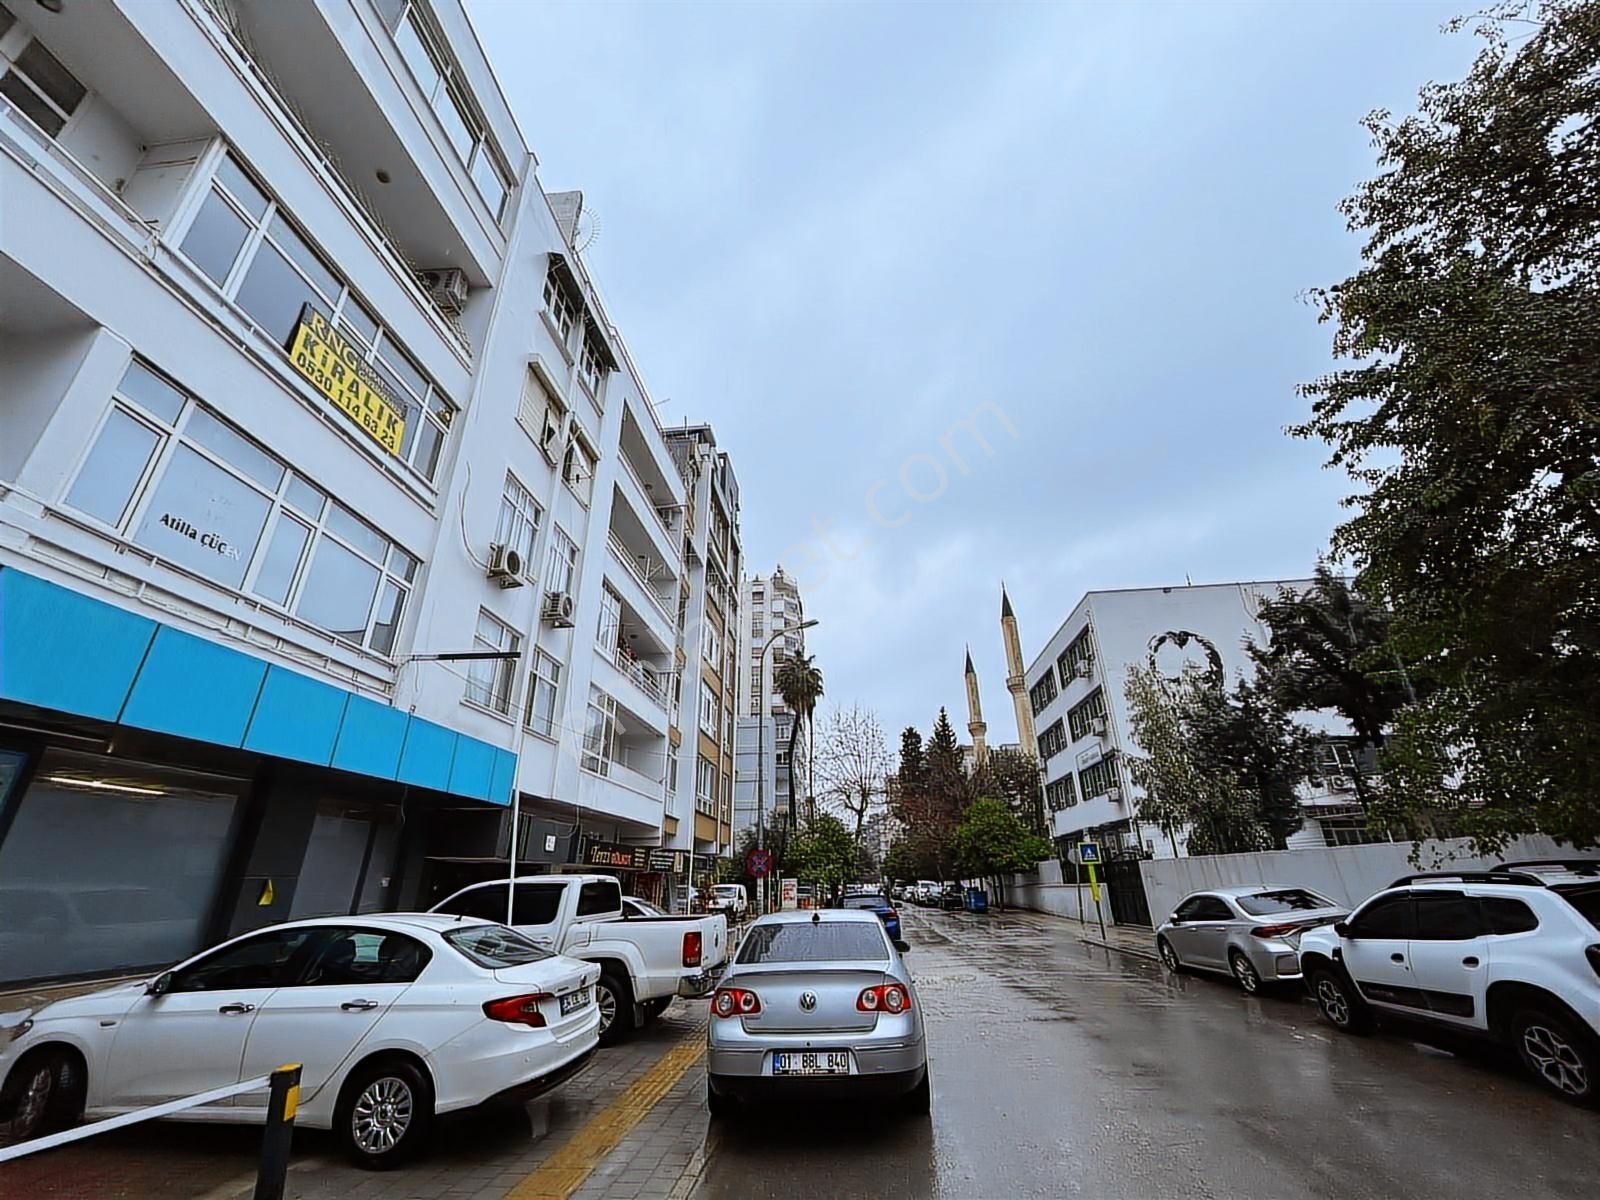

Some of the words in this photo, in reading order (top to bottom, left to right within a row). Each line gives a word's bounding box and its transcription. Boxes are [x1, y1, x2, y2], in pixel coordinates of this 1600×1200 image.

[311, 312, 359, 371] RNG
[296, 352, 333, 391] 0530
[337, 389, 360, 417] 114
[363, 414, 378, 434] 63
[381, 429, 394, 450] 23
[160, 512, 197, 540] Atilla
[779, 1054, 791, 1069] 01
[827, 1053, 846, 1068] 840
